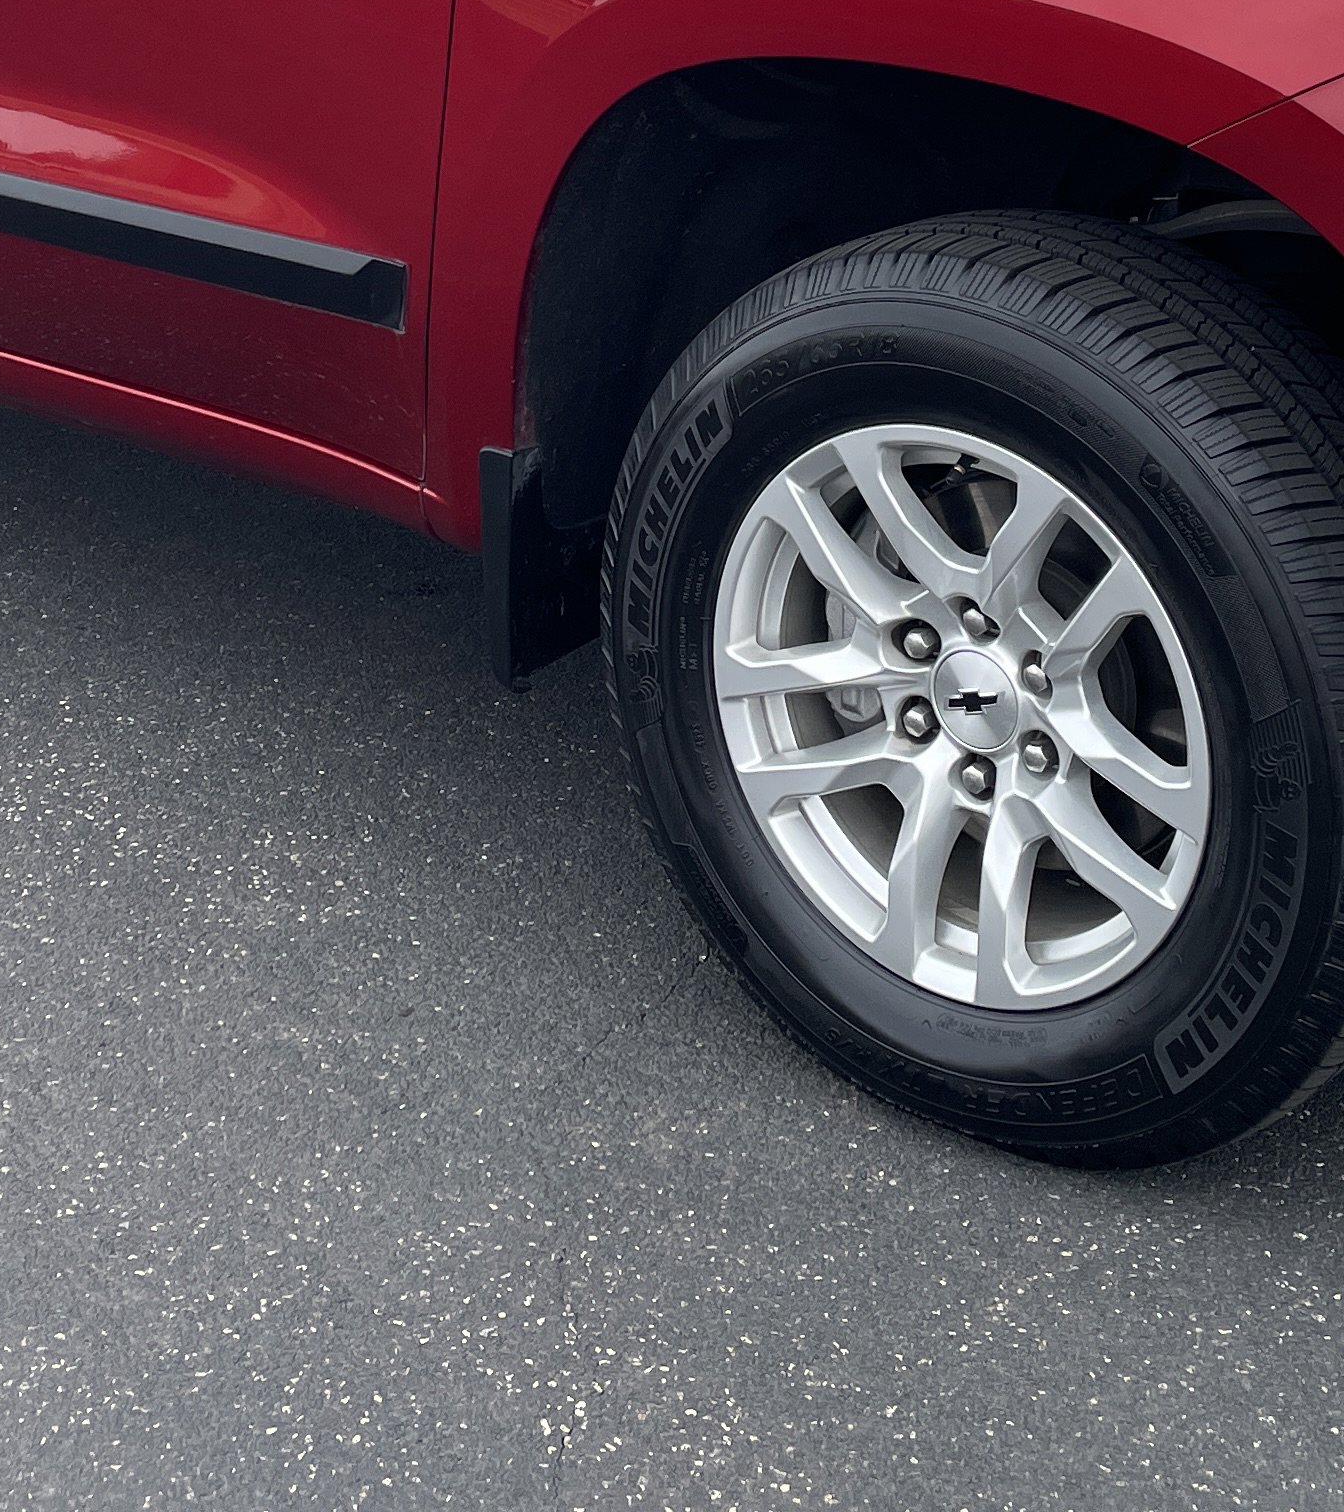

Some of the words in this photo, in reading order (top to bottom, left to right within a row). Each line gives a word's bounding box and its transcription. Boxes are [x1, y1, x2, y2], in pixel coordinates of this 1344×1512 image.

[628, 398, 724, 642] MICHELIN
[1166, 486, 1217, 549] MICHELIN
[1163, 820, 1298, 1080] MICHELIN
[963, 1068, 1146, 1117] DEFENDER
